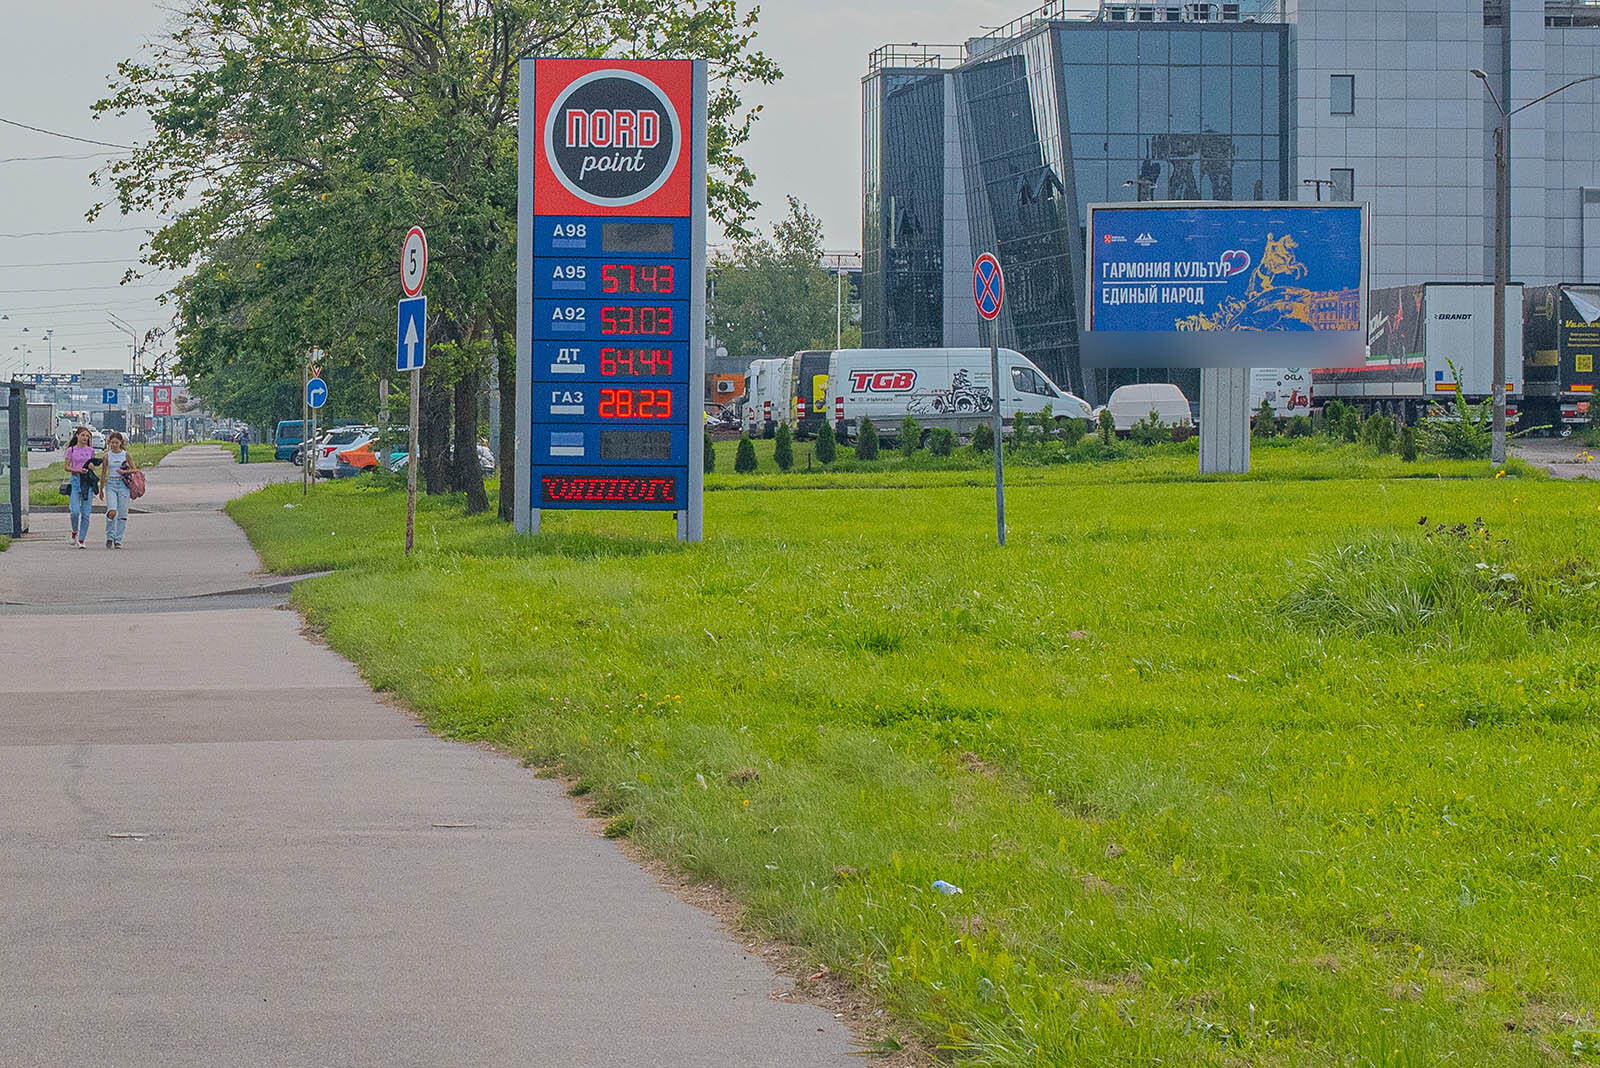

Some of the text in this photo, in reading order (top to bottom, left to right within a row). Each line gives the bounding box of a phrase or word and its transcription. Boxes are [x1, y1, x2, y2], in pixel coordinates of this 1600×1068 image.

[566, 109, 660, 148] NORD
[579, 149, 646, 181] point
[409, 249, 417, 275] 5
[1102, 261, 1231, 278] ГАРМОНИЯ КУЛЬТУР
[602, 264, 674, 293] 57.43
[1102, 284, 1205, 305] ЕДИНЫЙ НАРОД
[601, 306, 673, 335] 53.03
[556, 348, 673, 376] ДТ 64.44
[850, 371, 916, 392] TGB
[106, 390, 115, 402] P
[551, 388, 673, 418] ГАЗ 28.23
